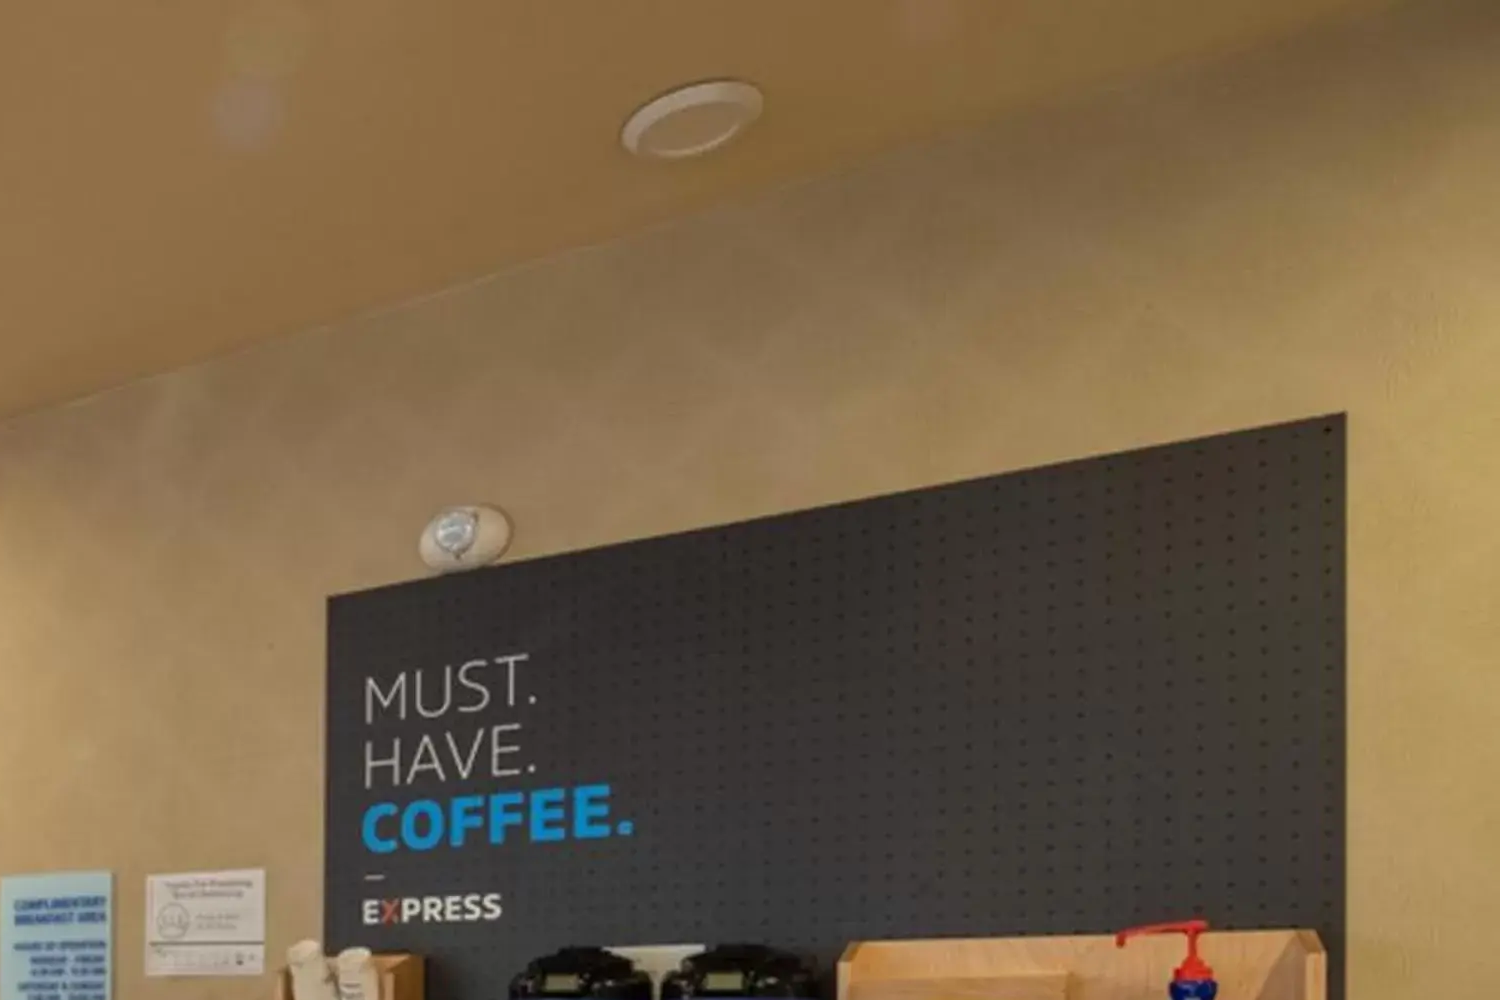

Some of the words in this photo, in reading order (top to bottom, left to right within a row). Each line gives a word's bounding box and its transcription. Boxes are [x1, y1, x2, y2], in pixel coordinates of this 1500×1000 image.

[365, 654, 537, 725] MUST.
[364, 723, 536, 789] HAVE.
[362, 784, 634, 853] COFFEE.
[362, 894, 502, 925] EXPRESS
